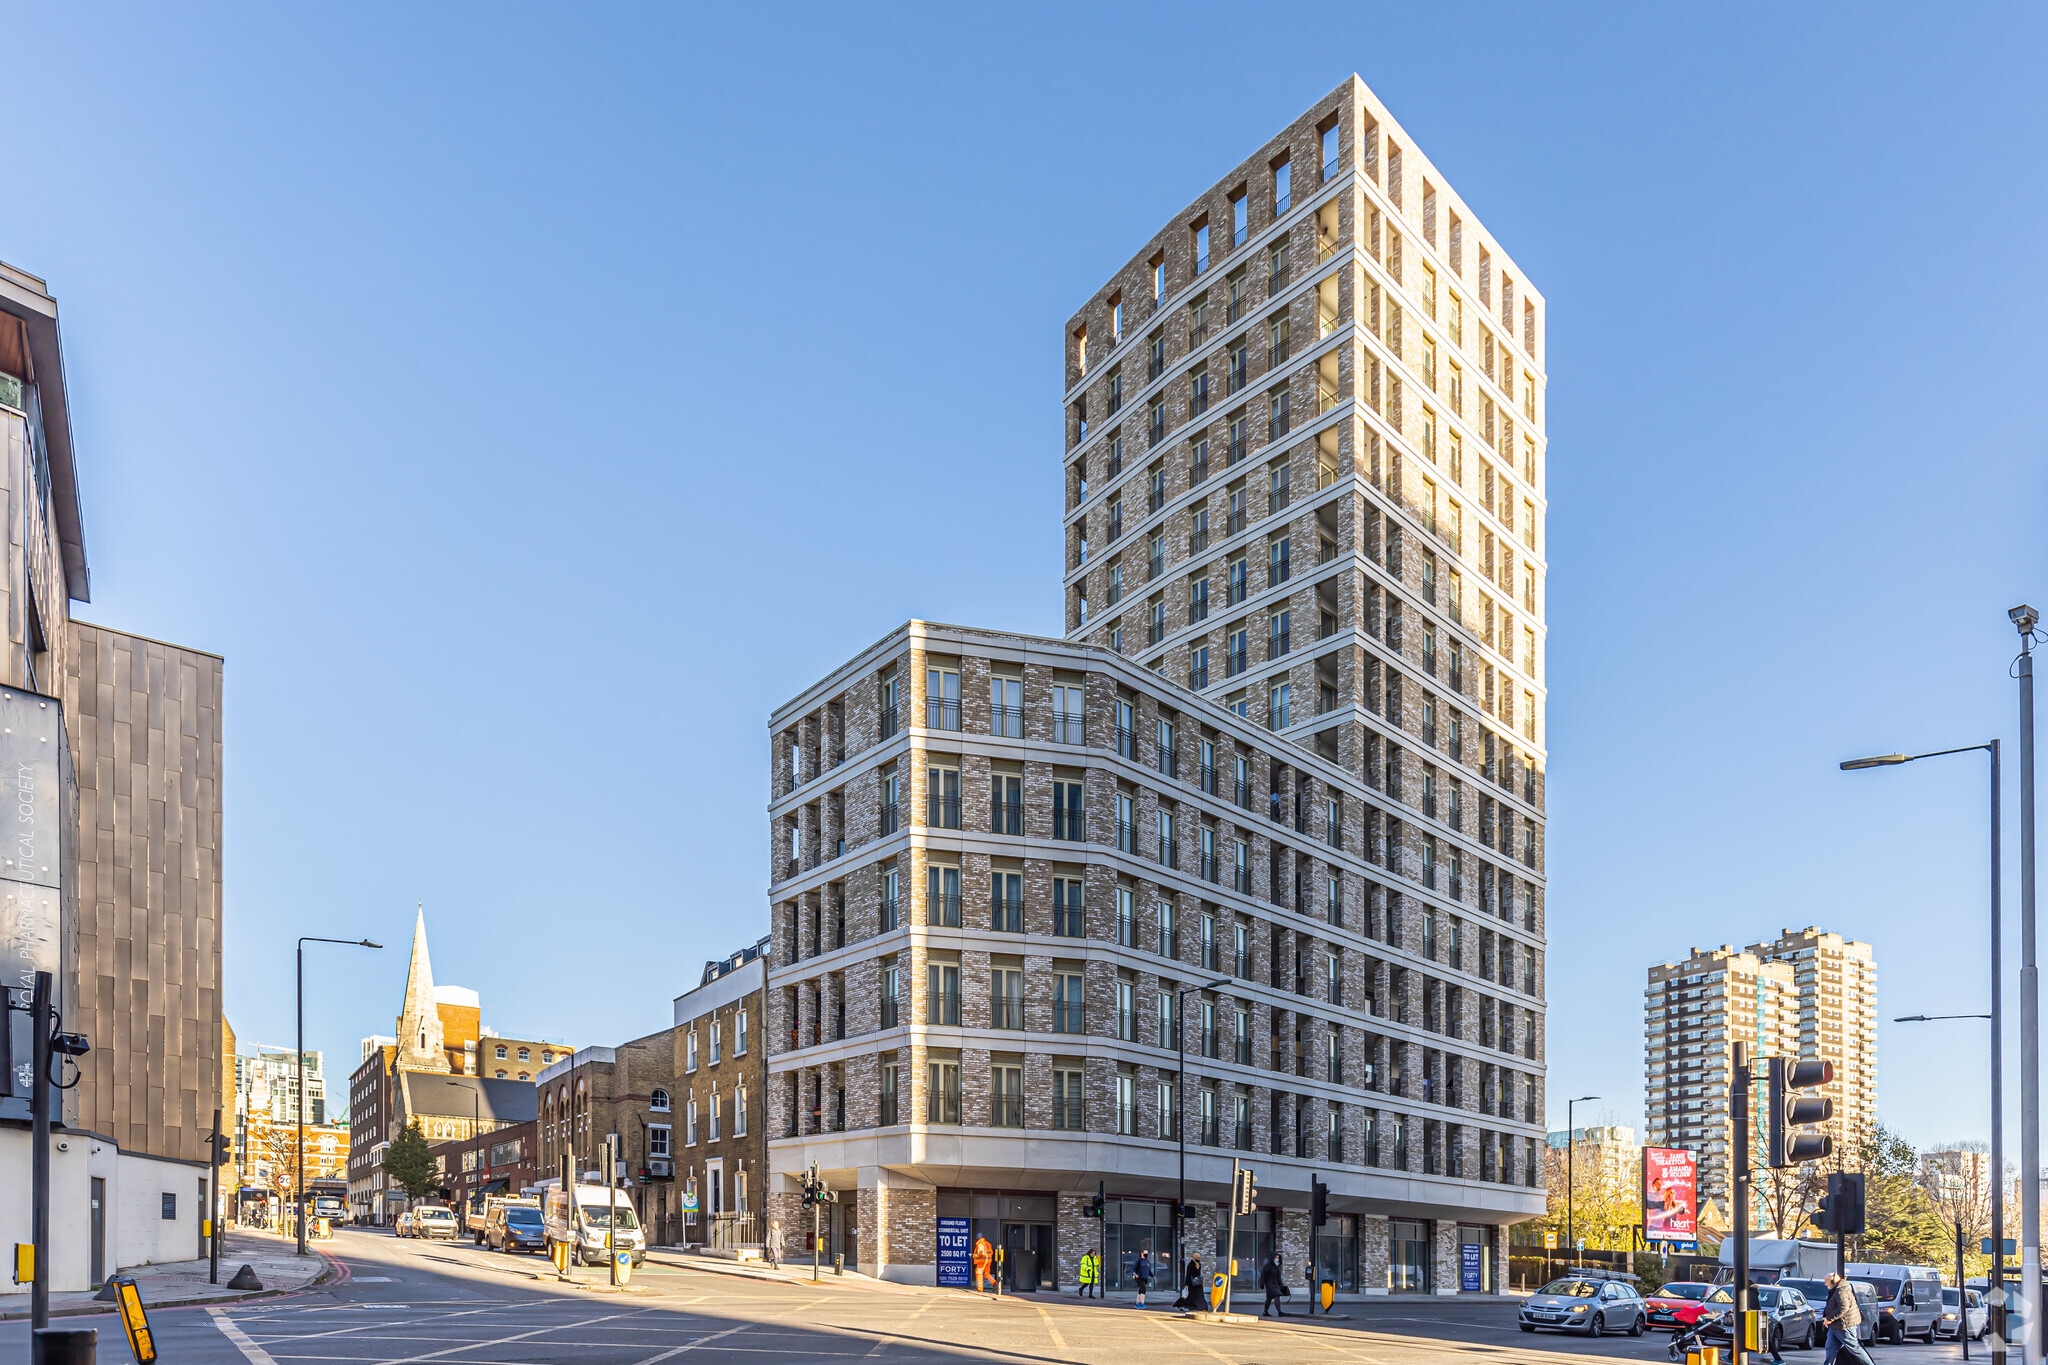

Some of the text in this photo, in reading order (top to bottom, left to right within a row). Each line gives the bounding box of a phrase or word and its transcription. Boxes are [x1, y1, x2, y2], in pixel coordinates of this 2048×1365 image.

[18, 761, 35, 1012] ROYAL PHARMACEUTICAL SOCIETY
[1670, 1218, 1690, 1228] heart
[939, 1235, 968, 1247] TO LET
